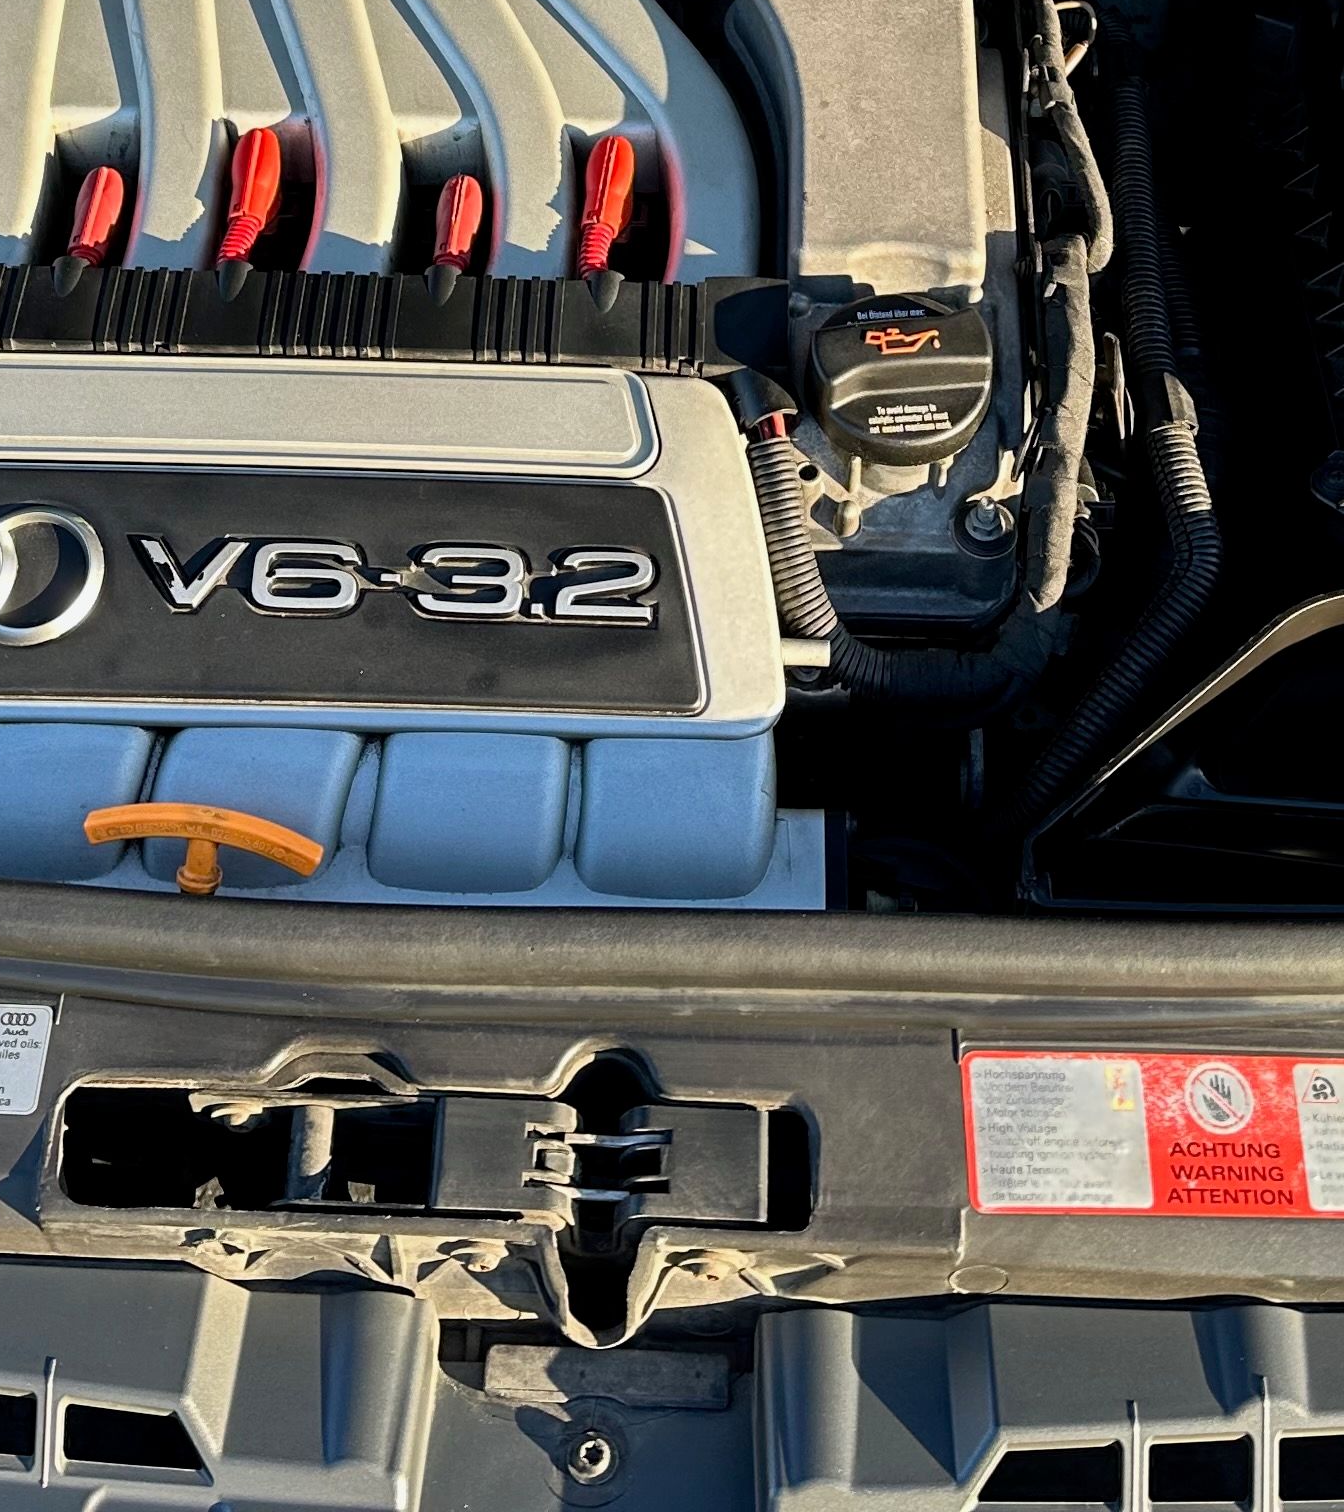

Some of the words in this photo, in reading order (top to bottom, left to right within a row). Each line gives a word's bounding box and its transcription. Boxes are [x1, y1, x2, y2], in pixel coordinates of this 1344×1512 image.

[876, 406, 886, 415] To
[886, 405, 903, 415] avoid
[904, 404, 929, 414] damage
[131, 535, 654, 625] V6-3.2
[1, 1028, 29, 1036] Audi
[983, 1069, 1066, 1081] Hochspannung
[987, 1123, 1013, 1135] High
[1017, 1123, 1058, 1136] Voltage
[1169, 1141, 1281, 1159] ACHTUNG
[990, 1165, 1023, 1175] Haute
[1169, 1164, 1284, 1182] WARNING
[1167, 1187, 1294, 1206] ATTENTION
